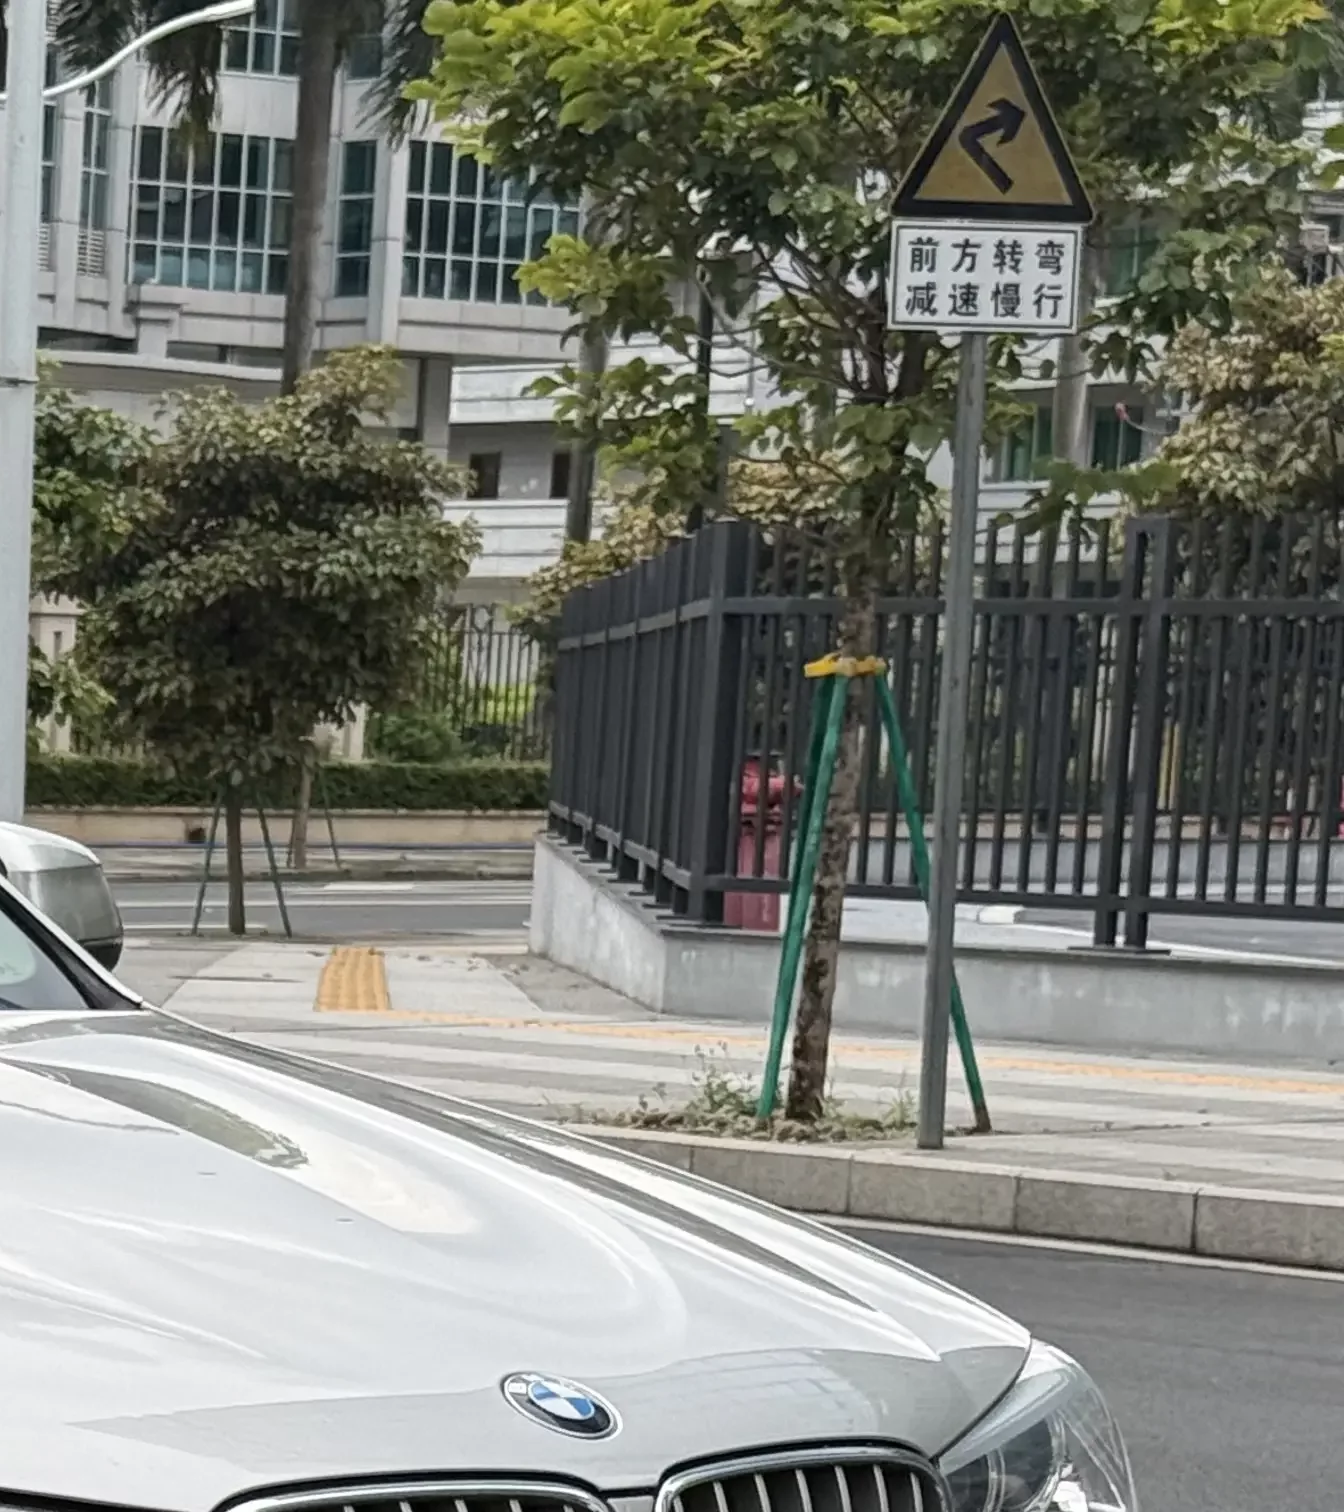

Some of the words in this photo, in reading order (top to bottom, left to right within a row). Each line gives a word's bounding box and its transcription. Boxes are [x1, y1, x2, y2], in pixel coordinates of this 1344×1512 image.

[907, 236, 1065, 276] 前方转弯
[905, 281, 1065, 319] 减速慢行
